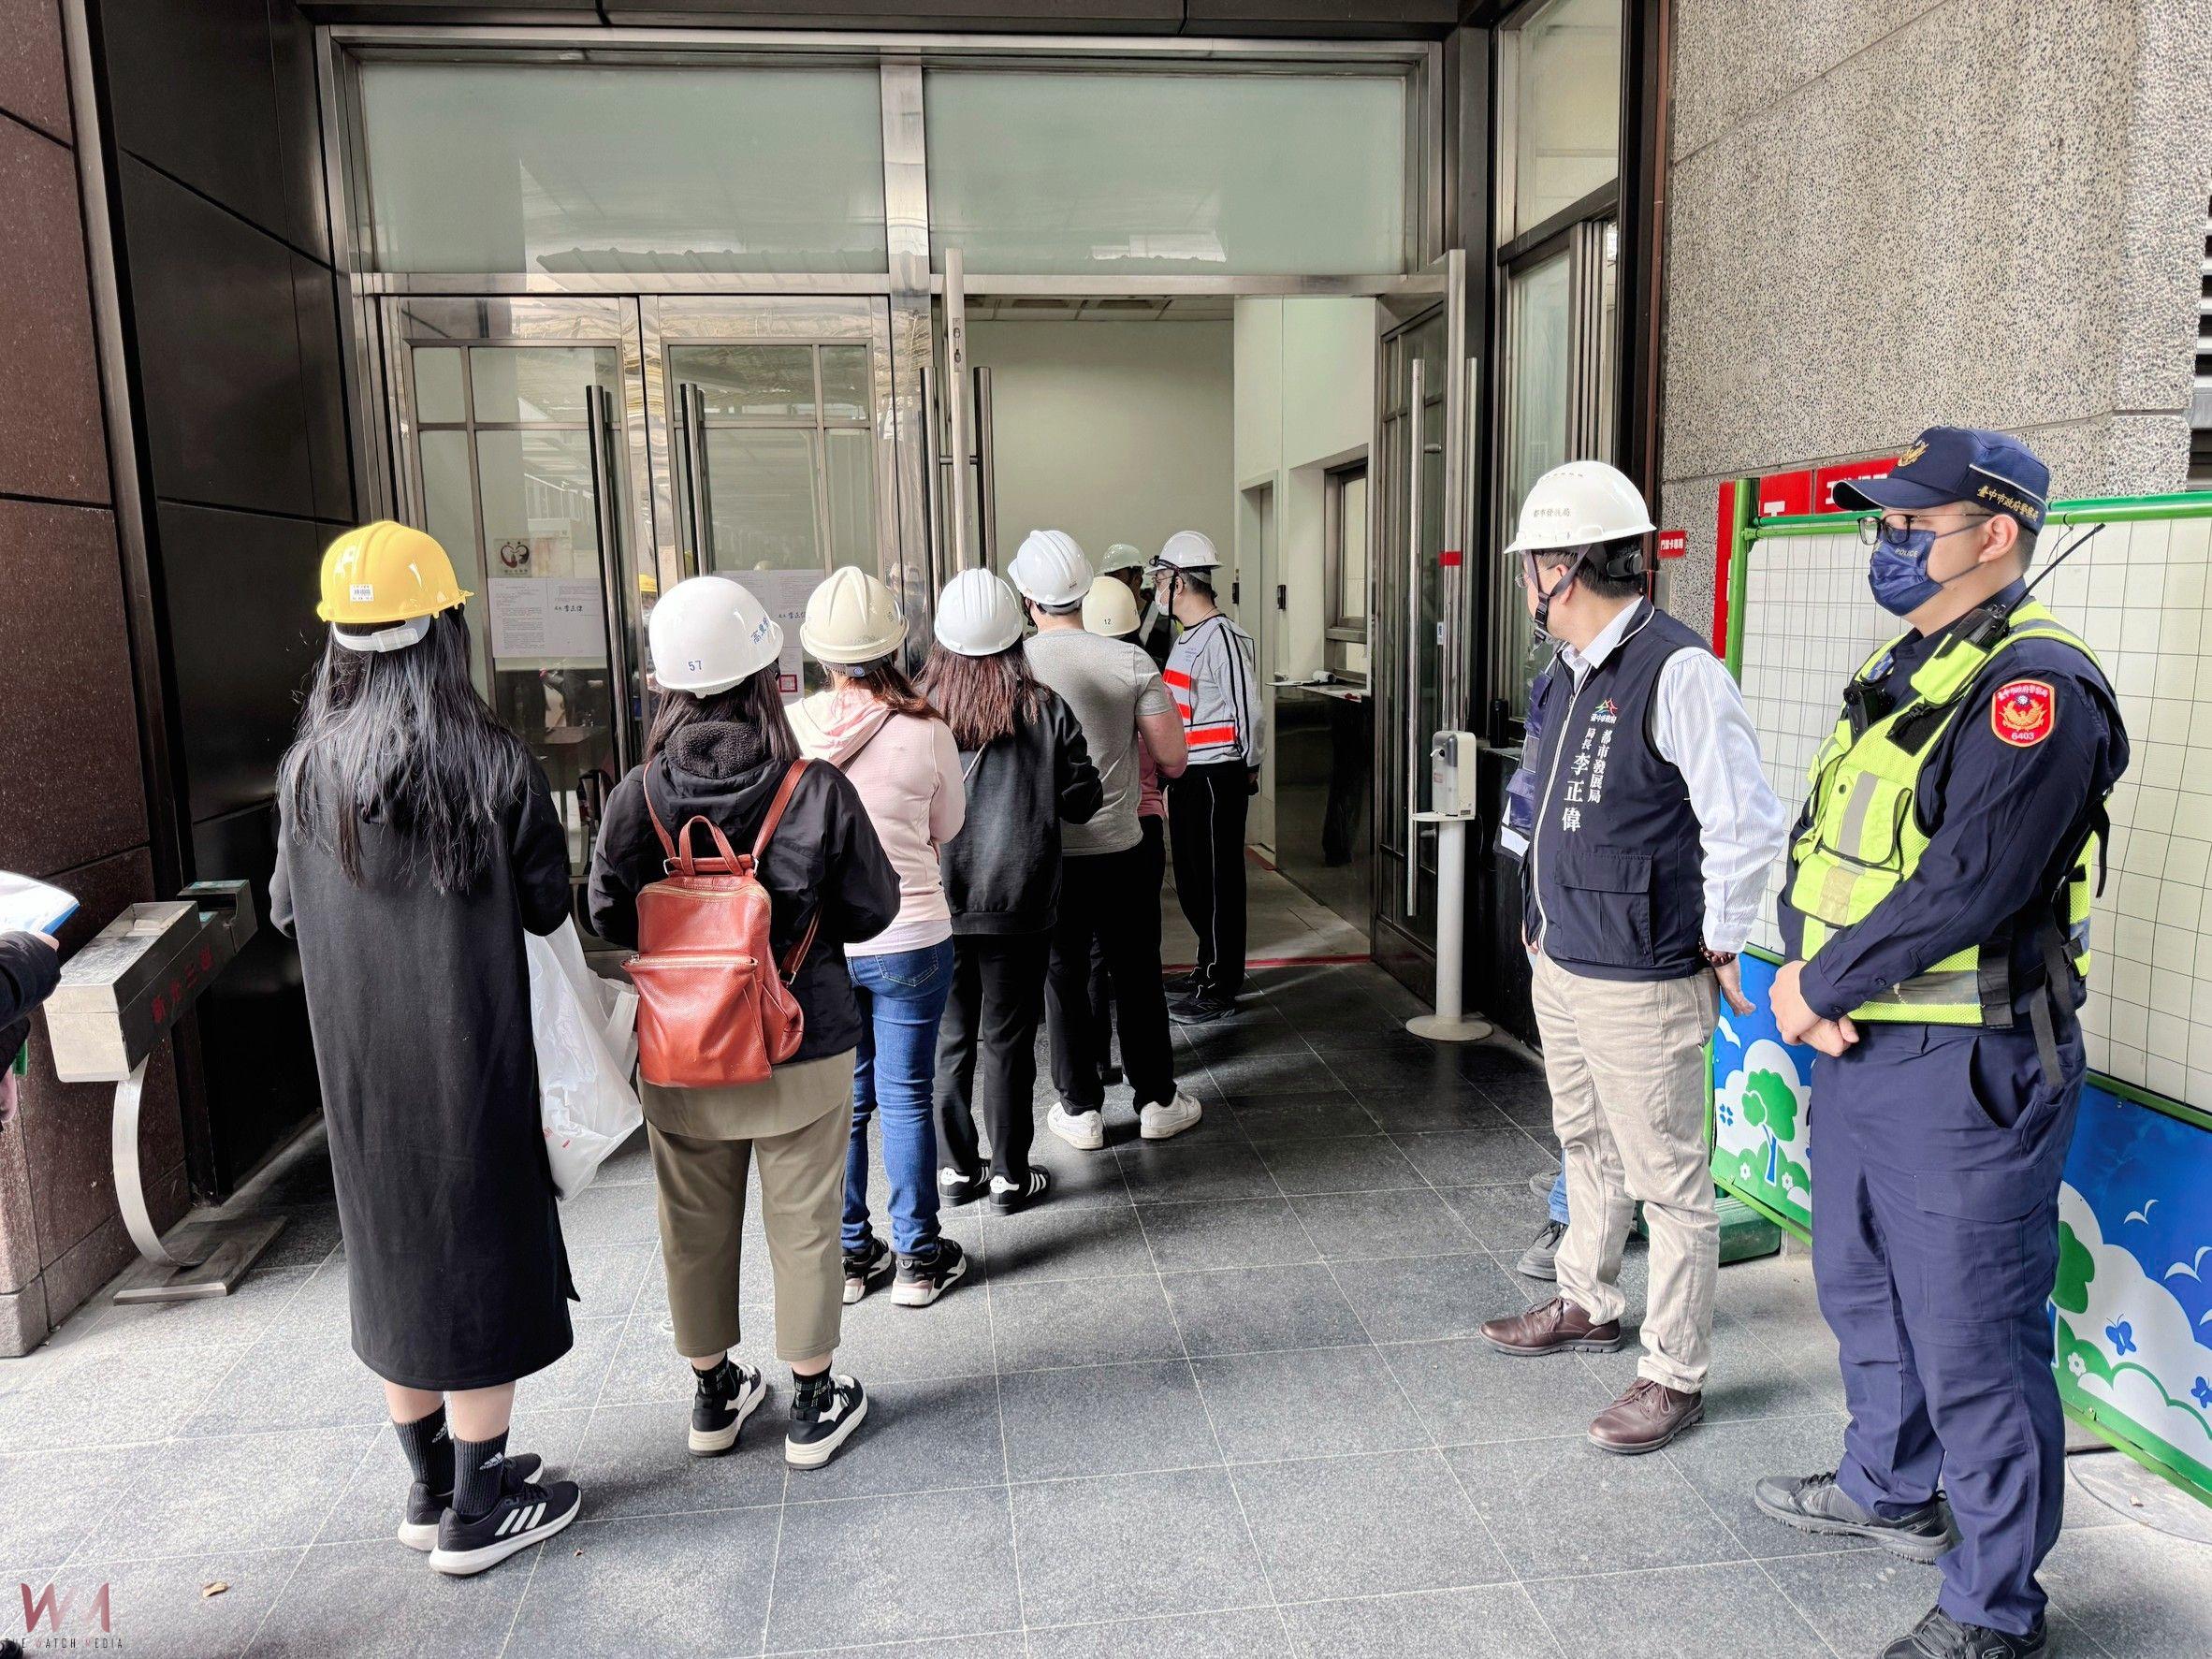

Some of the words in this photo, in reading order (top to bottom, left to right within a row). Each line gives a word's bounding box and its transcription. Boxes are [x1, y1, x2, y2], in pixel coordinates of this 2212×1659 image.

[1895, 547, 1918, 558] POLICE
[688, 660, 702, 672] 57
[2011, 732, 2035, 741] 6403
[1588, 729, 1613, 805] 都市發展局
[1562, 752, 1591, 833] 李正偉
